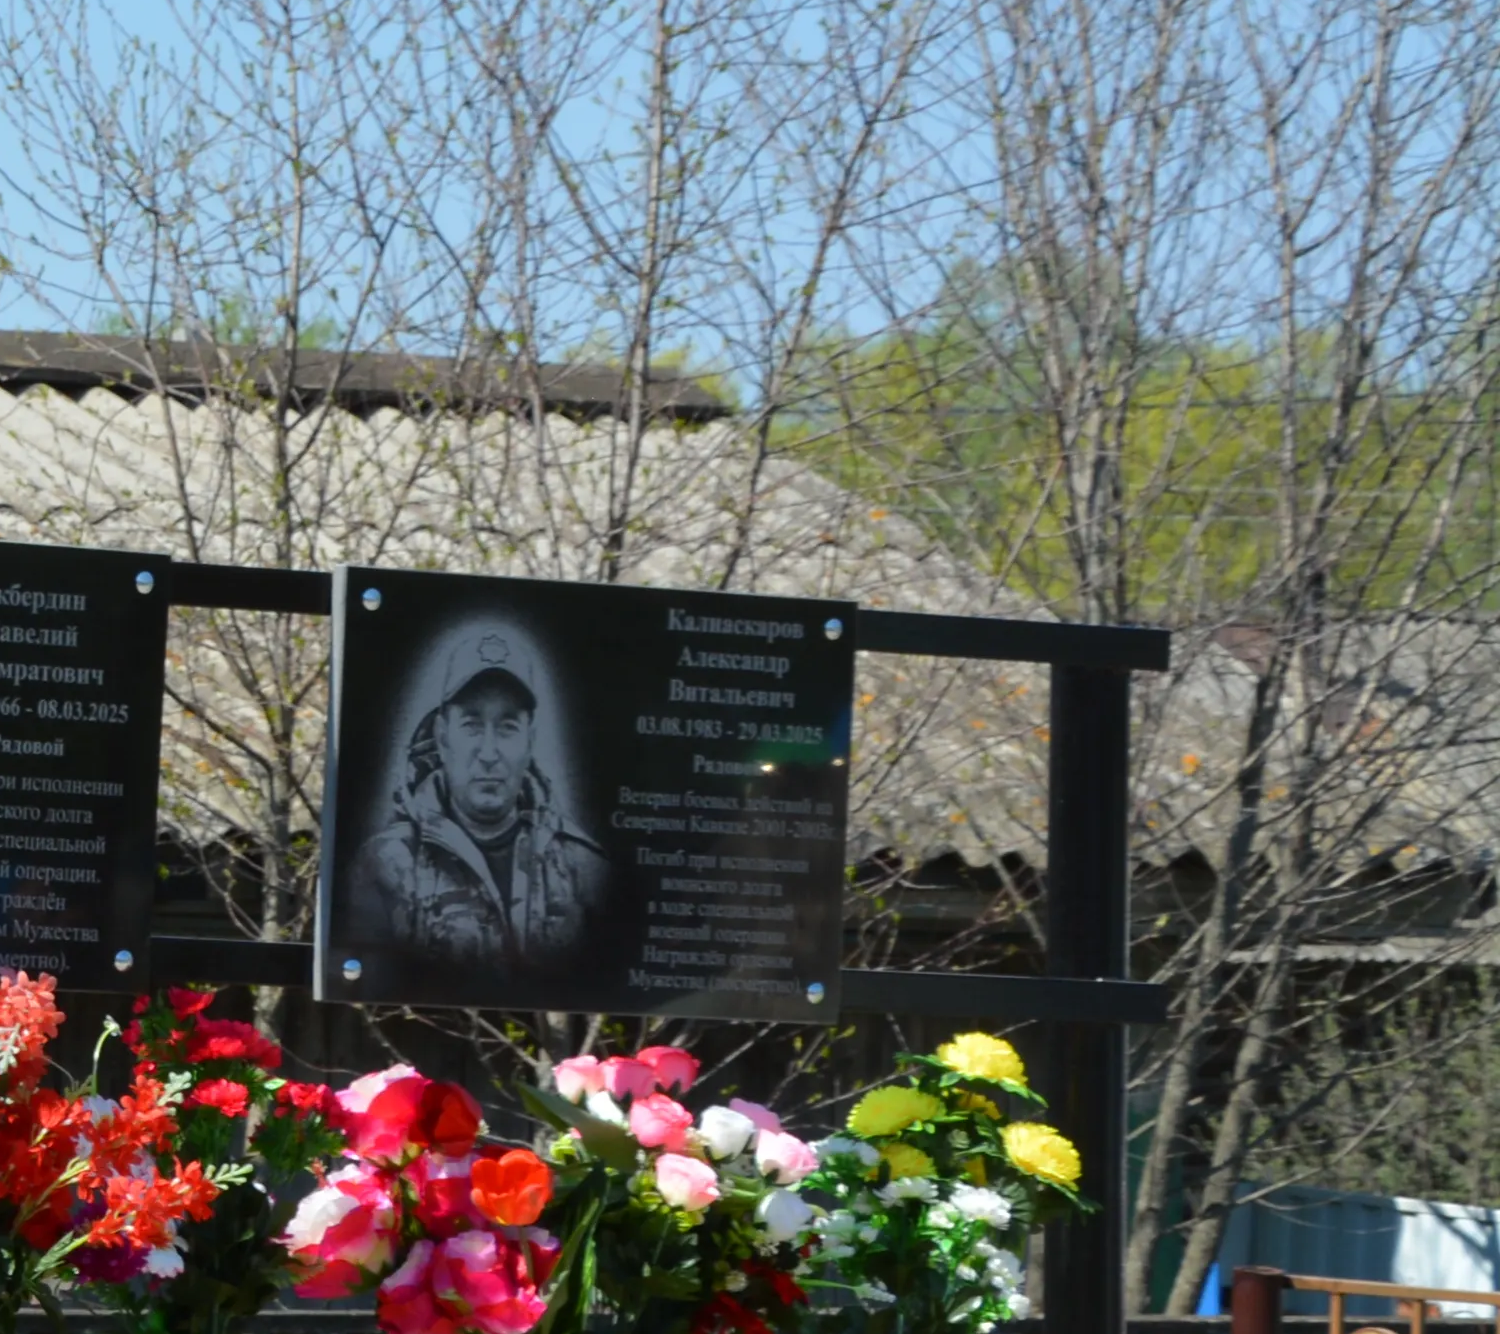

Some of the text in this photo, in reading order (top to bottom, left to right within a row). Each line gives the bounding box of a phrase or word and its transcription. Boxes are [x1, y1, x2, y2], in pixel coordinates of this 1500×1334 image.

[37, 698, 129, 724] 08.03.2025
[21, 776, 123, 796] исполнении
[43, 807, 93, 824] долга
[13, 918, 98, 944] Мужества
